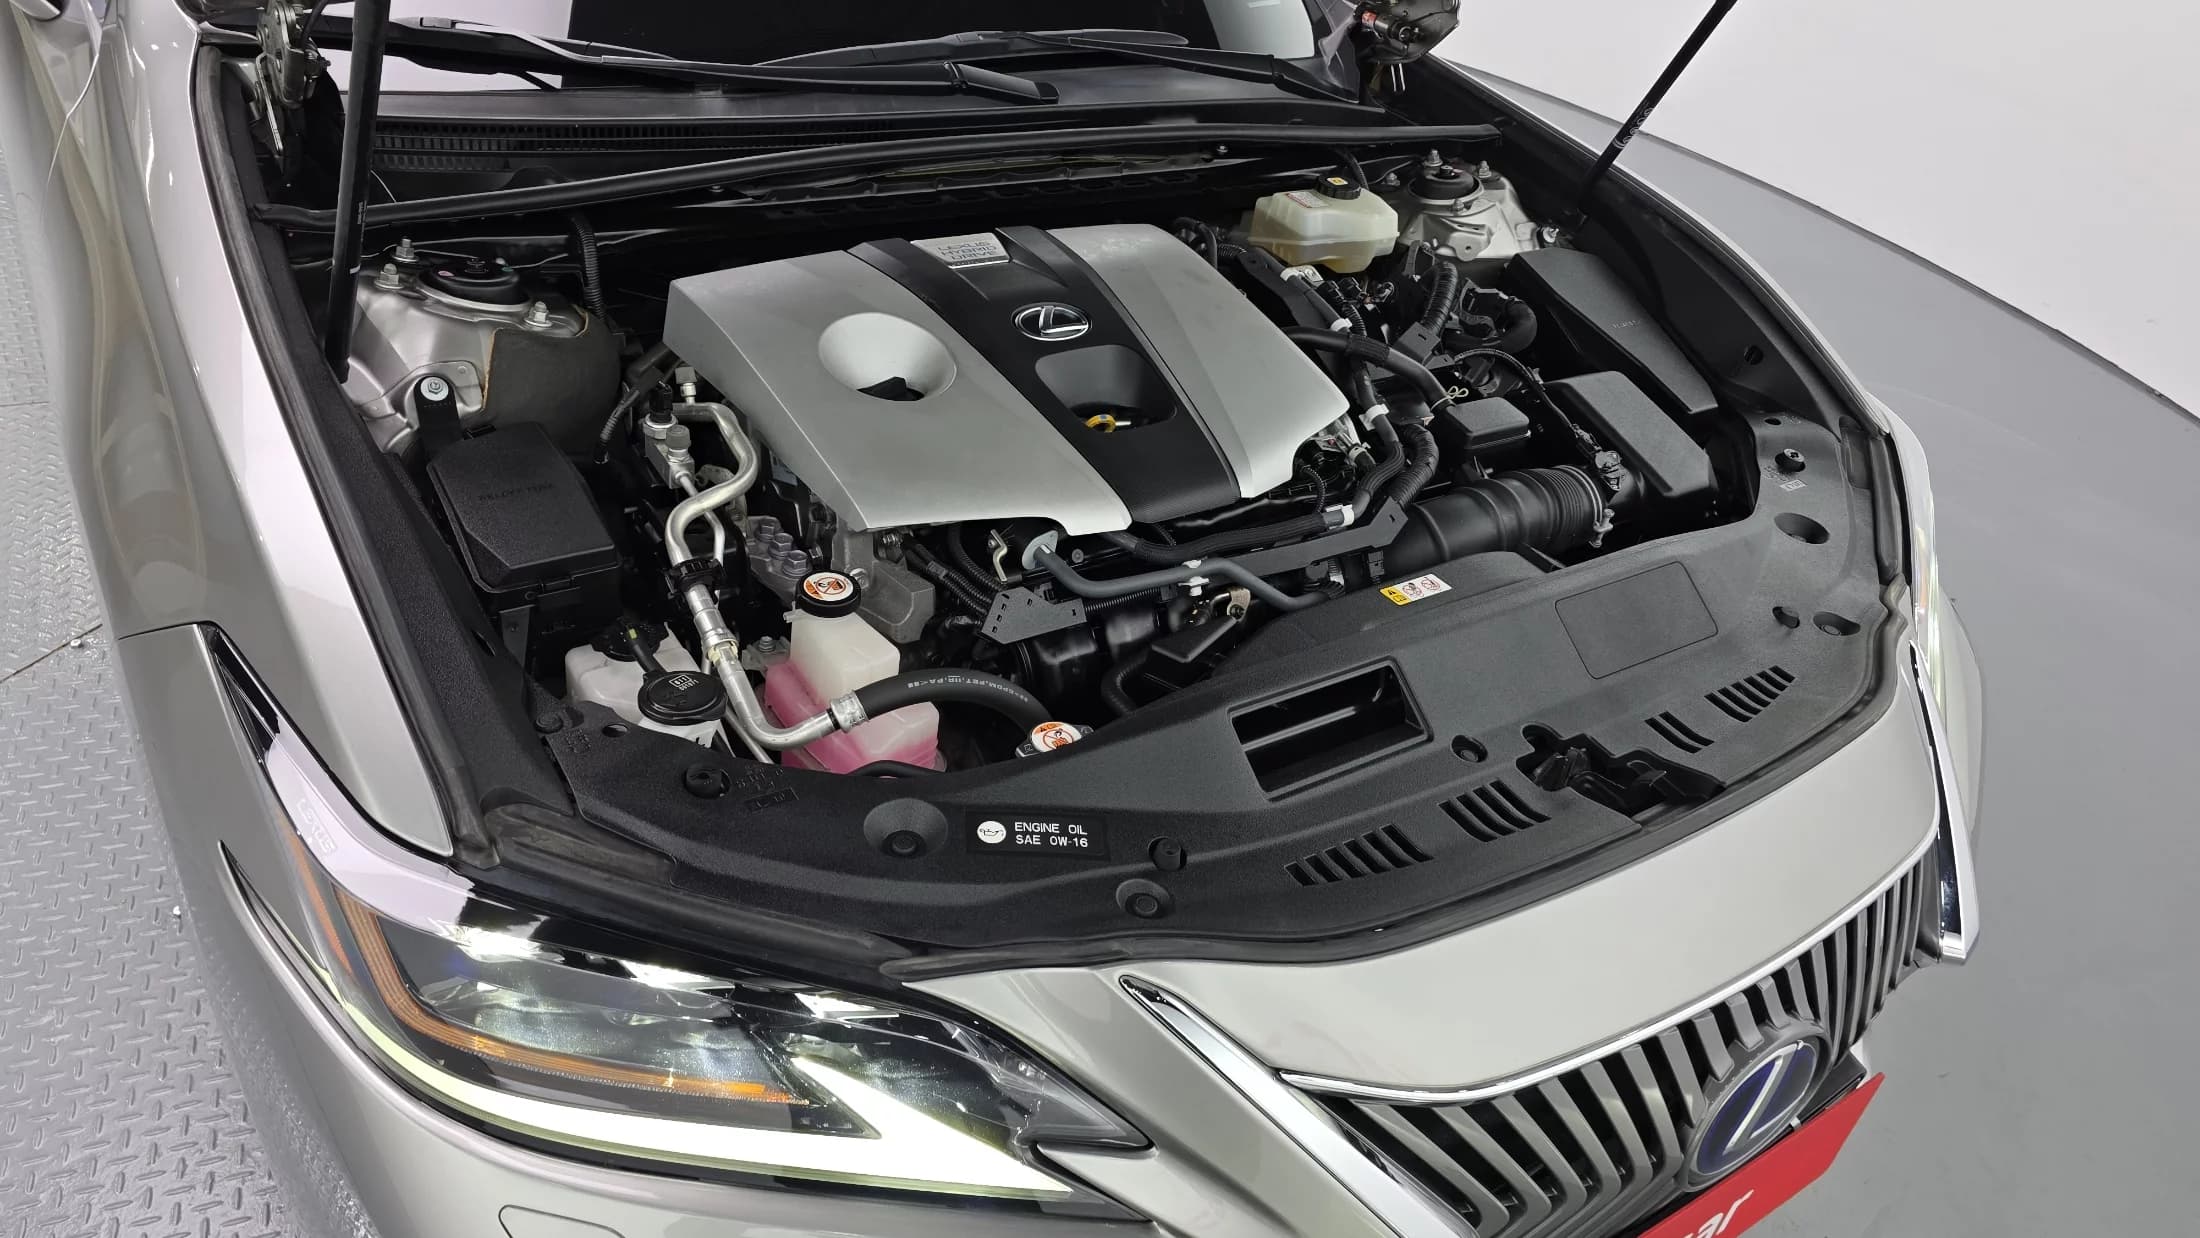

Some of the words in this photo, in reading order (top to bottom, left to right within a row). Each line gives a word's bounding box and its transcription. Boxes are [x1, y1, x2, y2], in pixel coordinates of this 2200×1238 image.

[941, 246, 997, 256] HYBRID
[951, 251, 997, 260] DRIVE
[1014, 822, 1060, 834] ENGINE
[1068, 824, 1088, 835] OIL
[1015, 834, 1042, 845] SAE
[1049, 835, 1088, 848] 0W-16
[1683, 1189, 1754, 1238] ar
